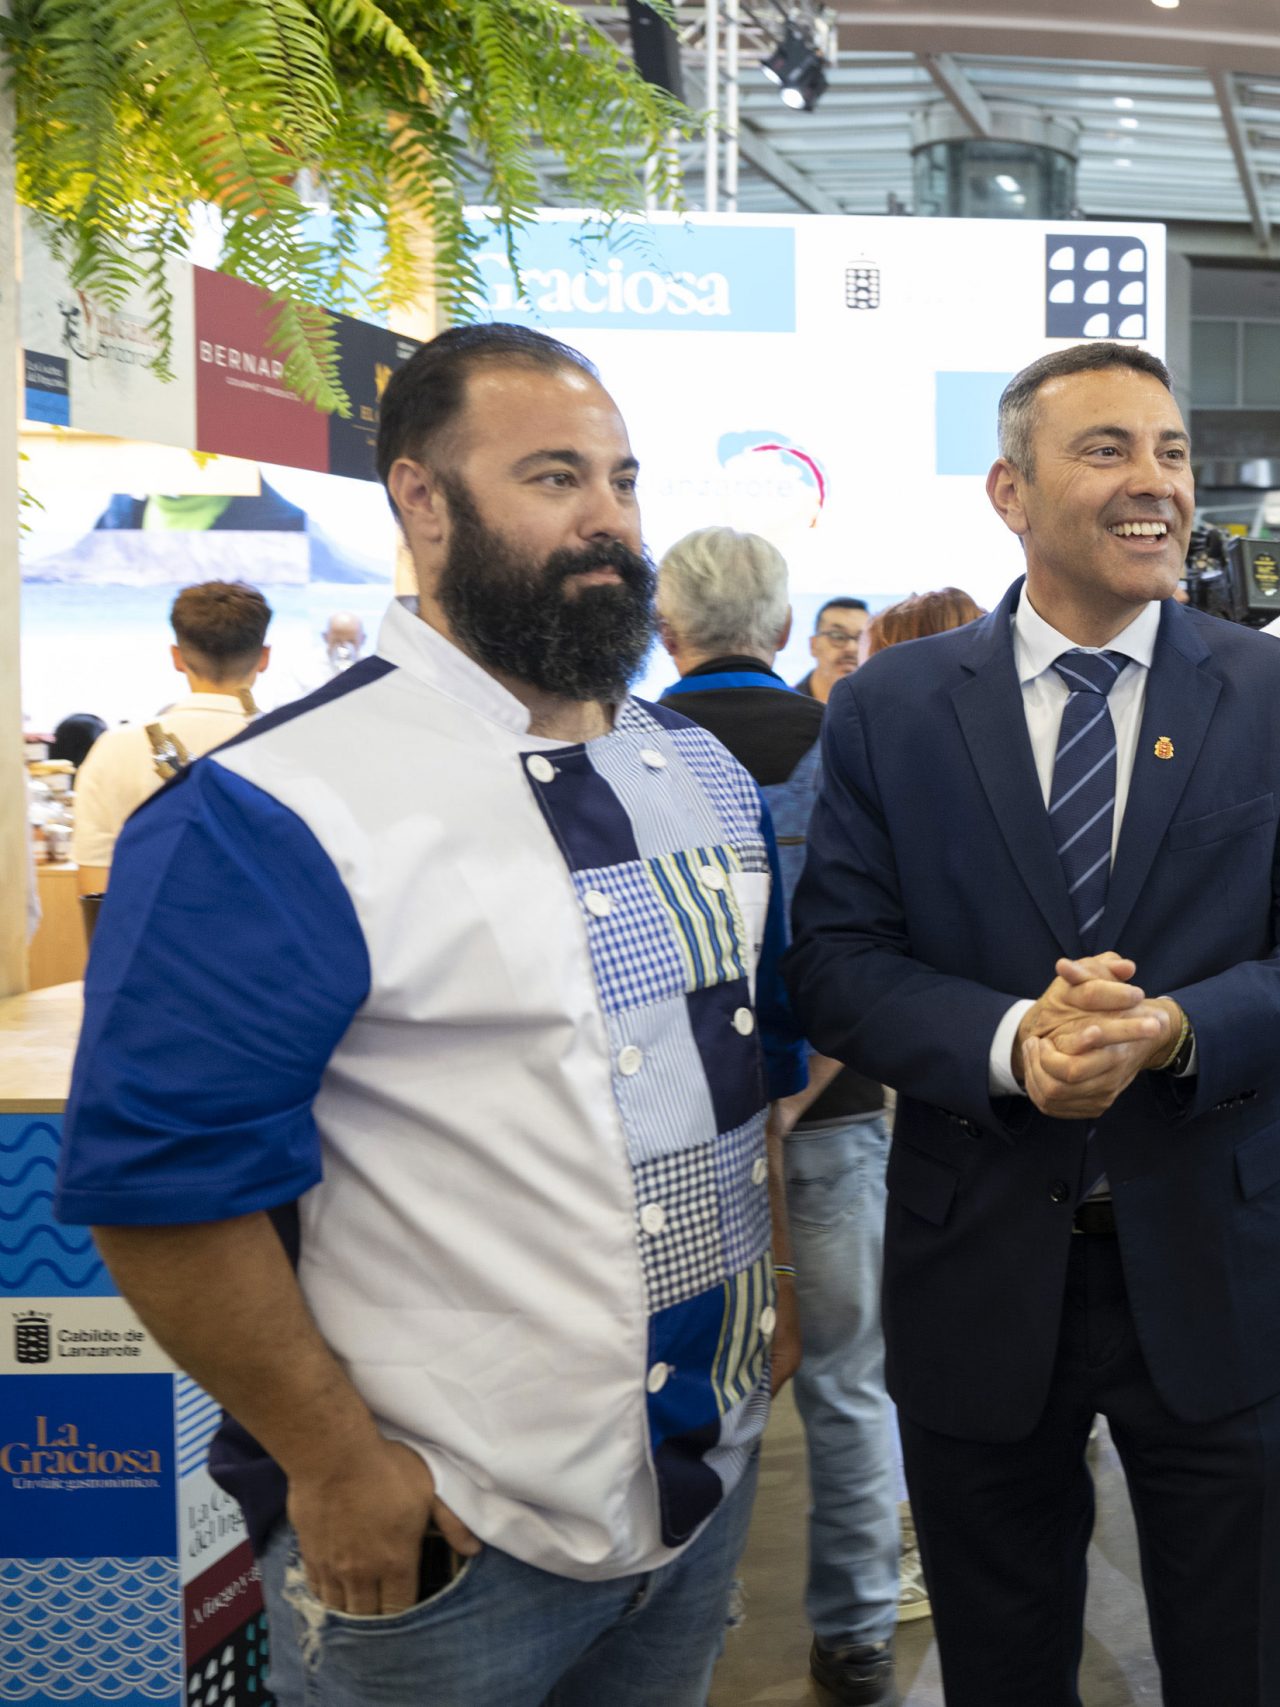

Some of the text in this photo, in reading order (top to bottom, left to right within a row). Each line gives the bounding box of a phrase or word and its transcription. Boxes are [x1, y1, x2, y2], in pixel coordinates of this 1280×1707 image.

[463, 252, 732, 316] Graciosa
[57, 1329, 145, 1343] Cabildo de
[57, 1344, 142, 1358] Lanzarote
[36, 1415, 79, 1447] La
[0, 1442, 162, 1474] Graciosa
